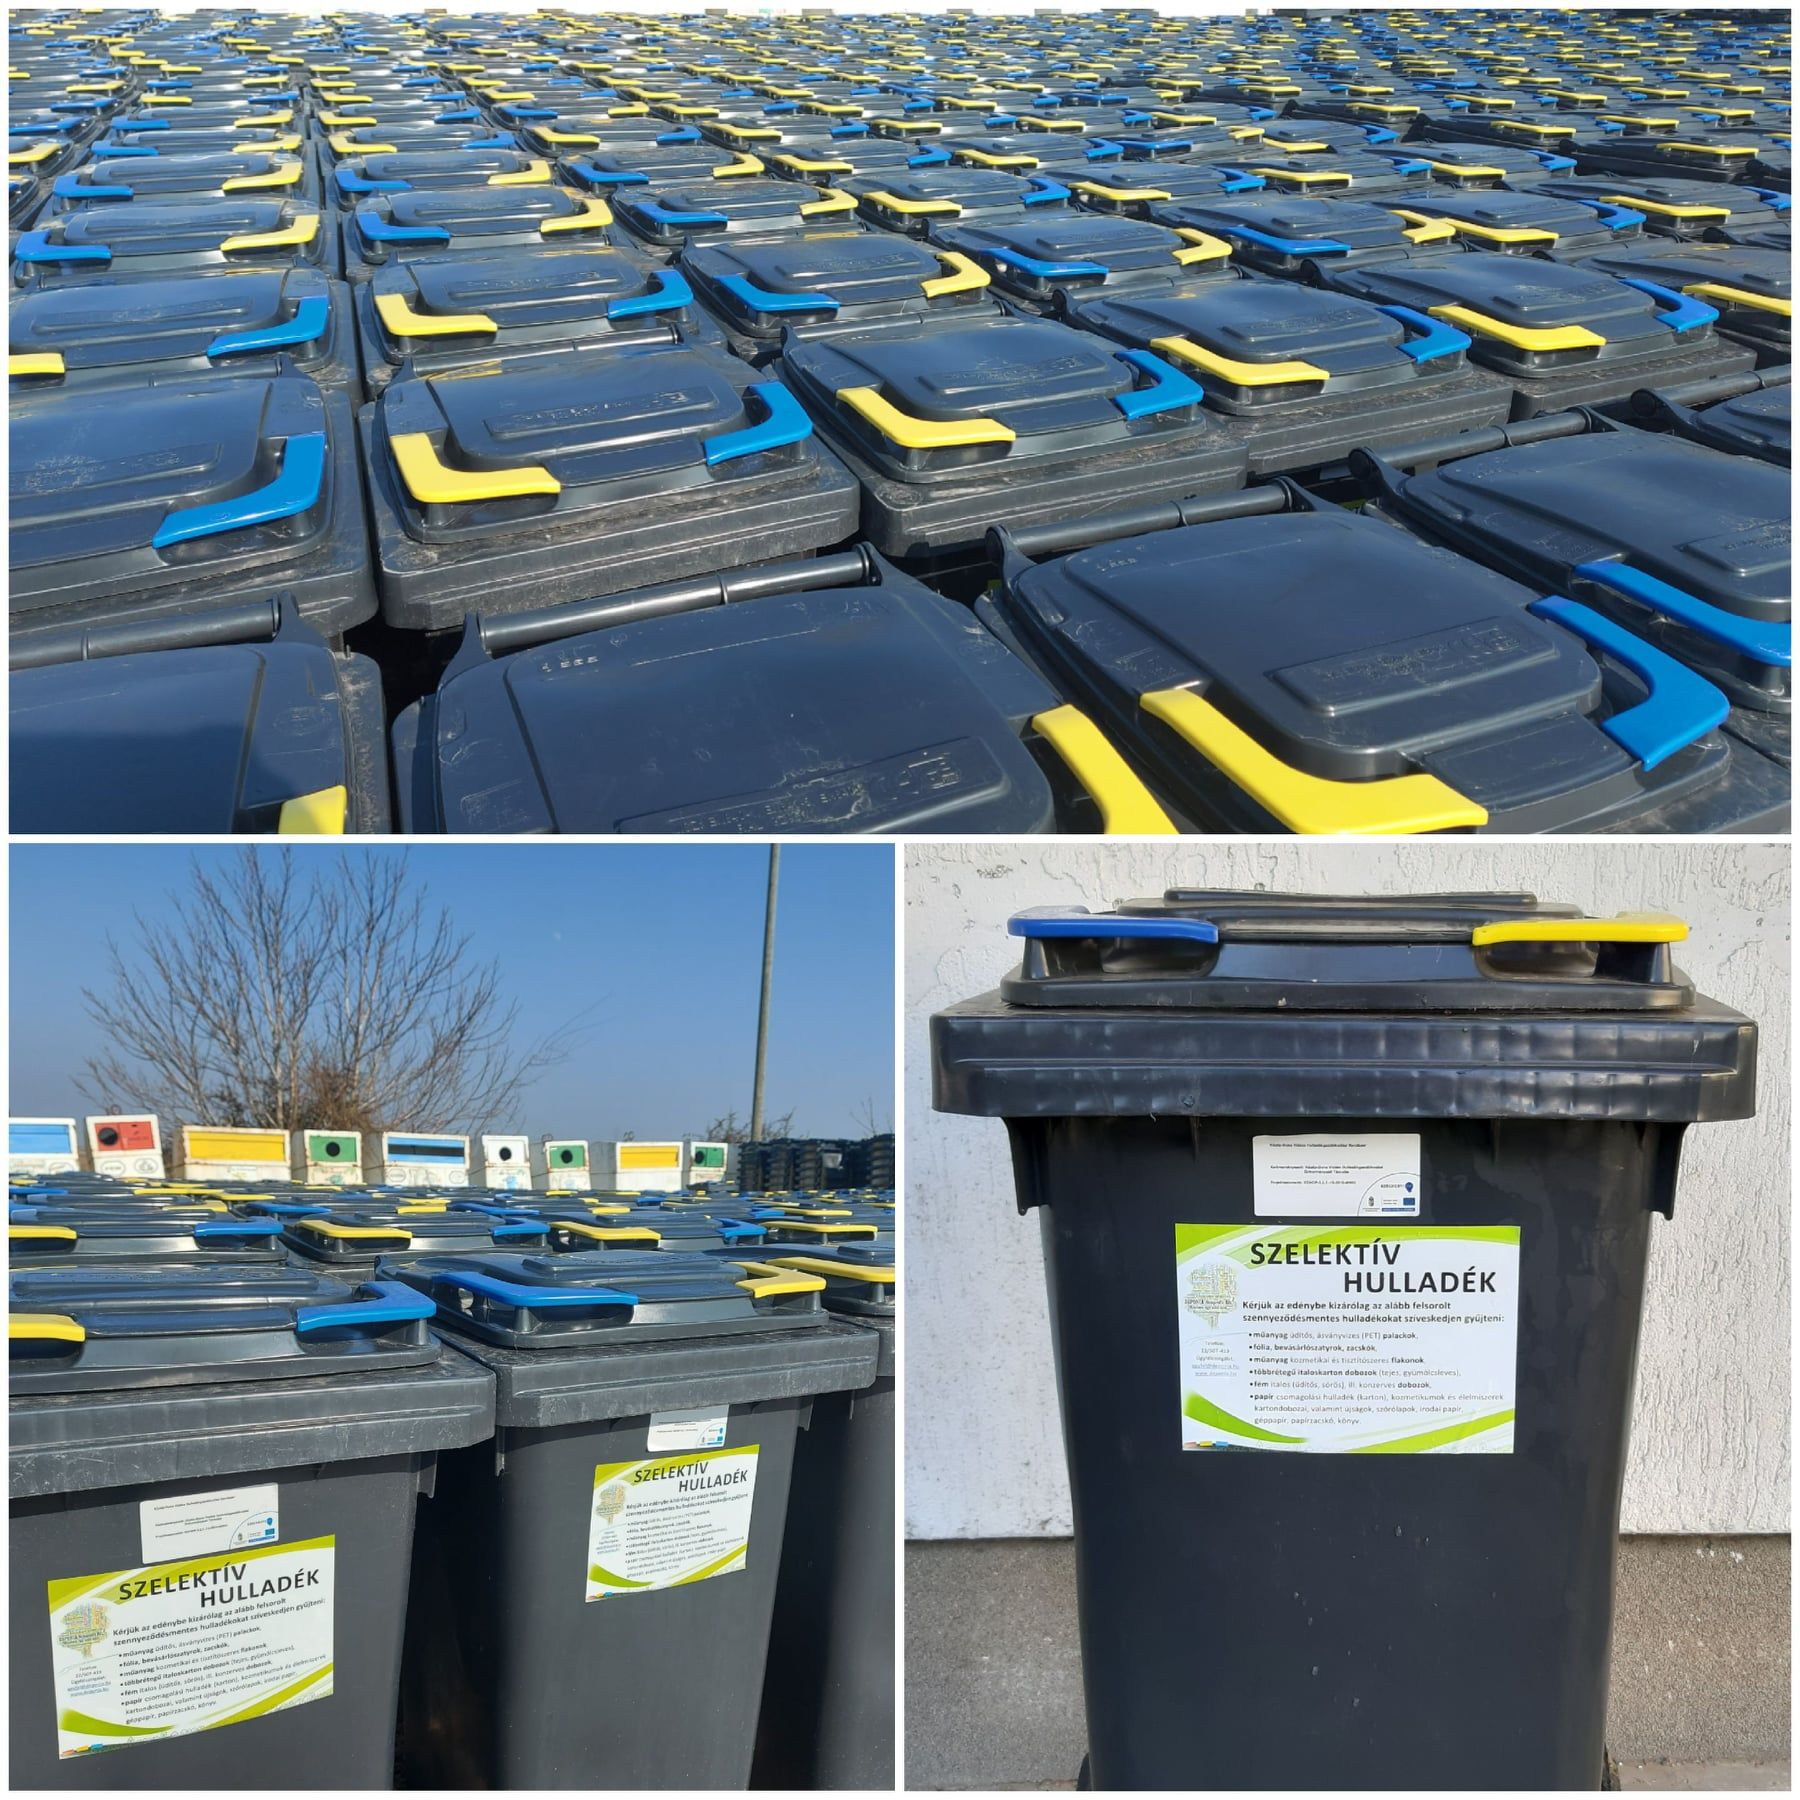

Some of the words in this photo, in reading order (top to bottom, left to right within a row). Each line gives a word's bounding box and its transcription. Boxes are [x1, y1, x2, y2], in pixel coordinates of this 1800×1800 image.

[1250, 1238, 1401, 1265] SZELEKTÍV
[1344, 1266, 1496, 1293] HULLADÉK
[1242, 1301, 1272, 1310] Kérjük
[1287, 1301, 1326, 1311] edénybe
[1329, 1301, 1370, 1311] kizárólag
[1384, 1301, 1410, 1309] alább
[1412, 1301, 1451, 1309] felsorolt
[1243, 1314, 1340, 1323] szennyeződésmentes
[1342, 1314, 1402, 1323] hulladékokat
[1404, 1314, 1462, 1324] szíveskedjen
[1464, 1315, 1504, 1324] gyűjteni:
[1253, 1331, 1288, 1340] műanyag
[1361, 1332, 1381, 1340] (PET)
[1253, 1343, 1272, 1351] fólia,
[1254, 1356, 1288, 1364] műanyag
[1290, 1356, 1330, 1364] kozmetikai
[1357, 1394, 1389, 1402] (karton),
[1254, 1405, 1309, 1413] kartondobozai,
[1254, 1416, 1289, 1424] géppapír,
[1290, 1417, 1335, 1425] papírzacskó,
[633, 1460, 709, 1483] SZELEKTÍV
[678, 1468, 748, 1492] HULLADÉK
[119, 1562, 247, 1601] SZELEKTÍV
[200, 1568, 320, 1608] HULLADÉK
